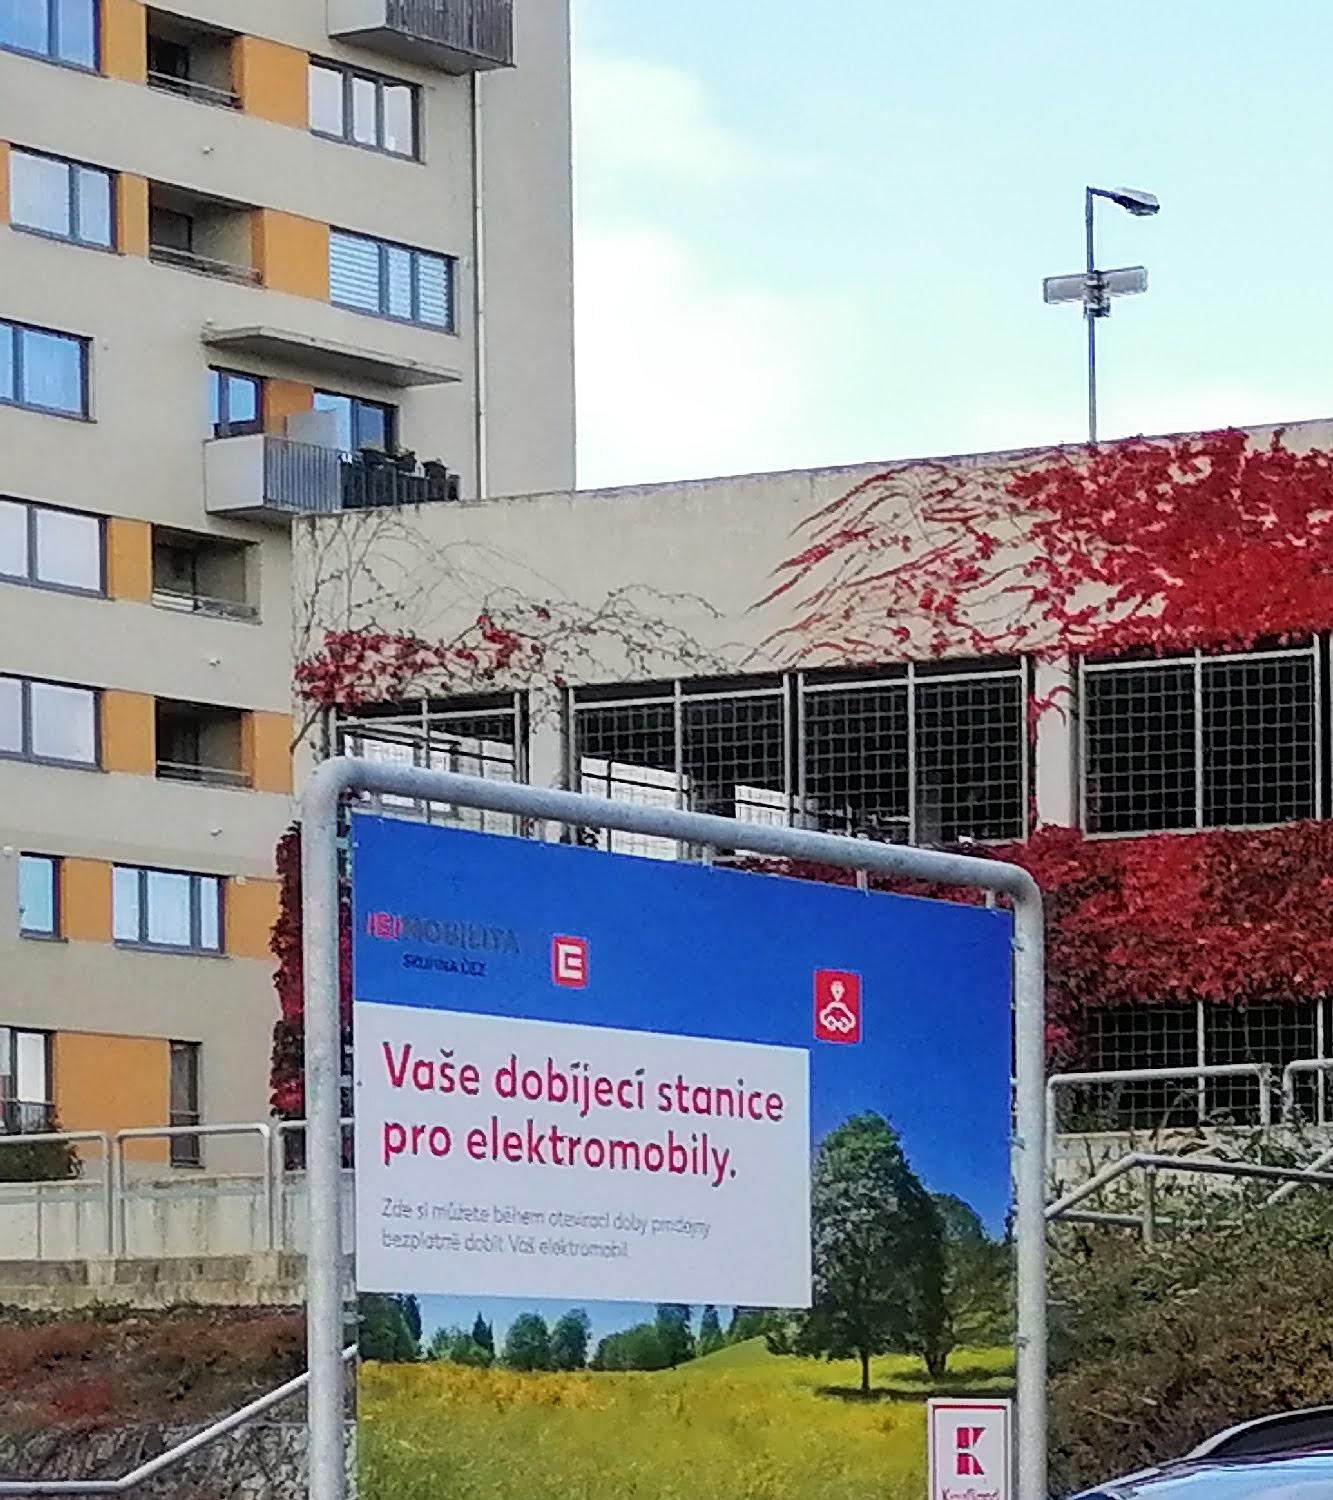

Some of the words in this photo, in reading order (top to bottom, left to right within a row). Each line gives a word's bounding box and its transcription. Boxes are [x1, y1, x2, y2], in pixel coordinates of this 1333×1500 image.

[382, 1041, 481, 1095] Vaše
[494, 1053, 646, 1118] dobíjecí
[657, 1074, 785, 1123] stanice
[383, 1120, 452, 1166] pro
[466, 1116, 738, 1189] elektromobily.
